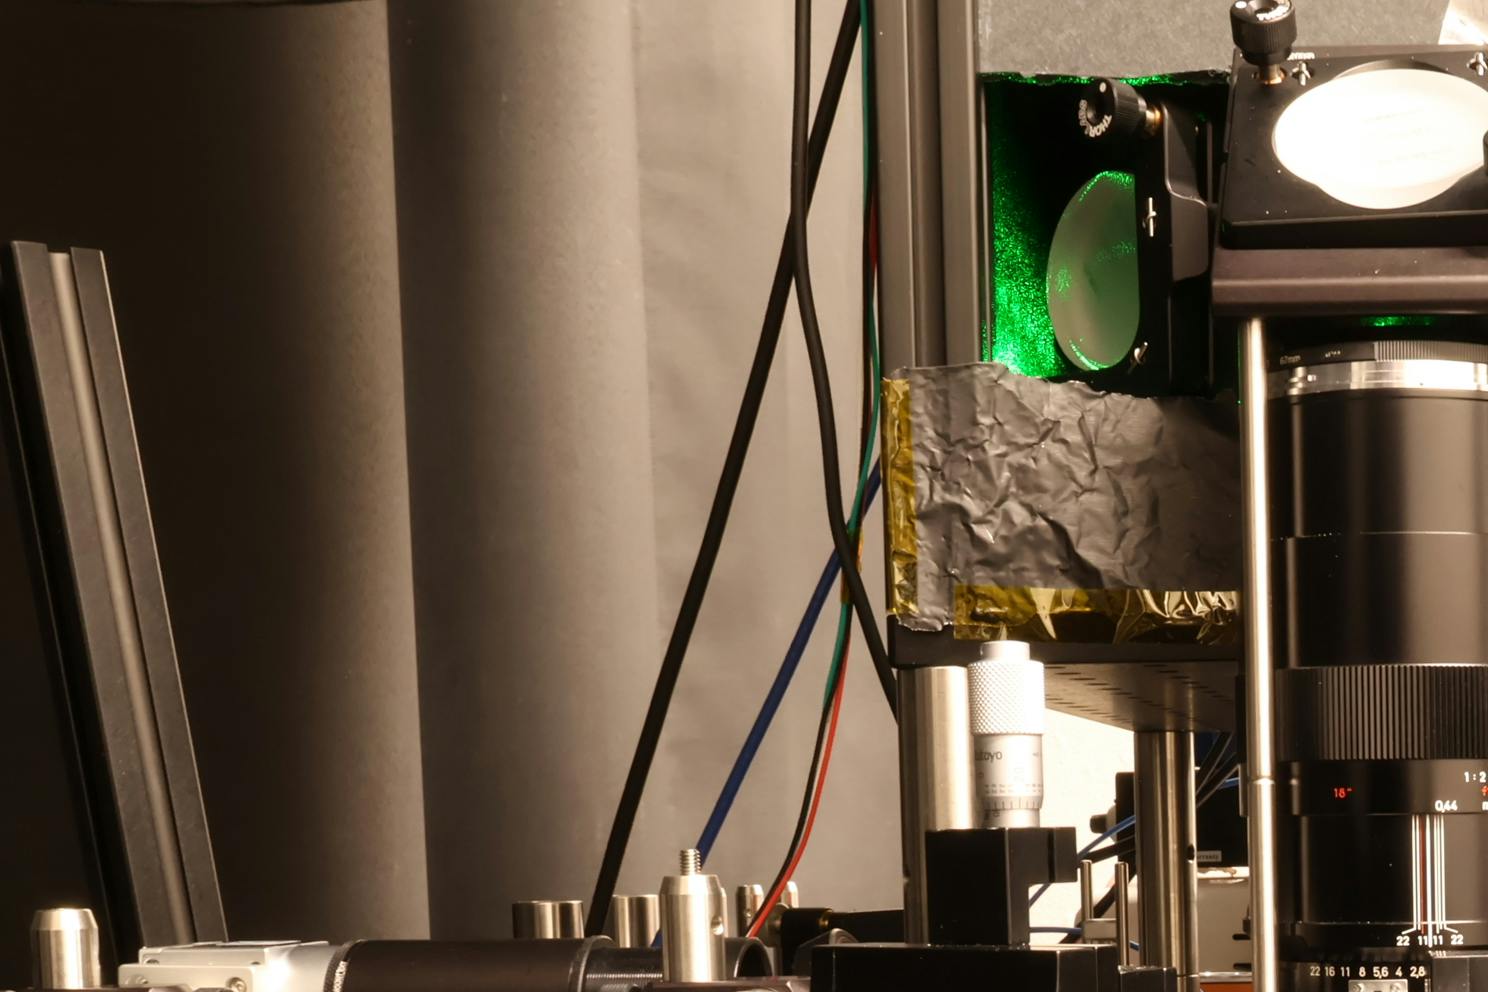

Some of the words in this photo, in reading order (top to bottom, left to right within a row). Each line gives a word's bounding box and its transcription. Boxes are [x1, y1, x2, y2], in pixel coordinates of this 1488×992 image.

[1396, 935, 1410, 946] 22
[1450, 933, 1464, 945] 22
[1309, 966, 1321, 977] 22
[1324, 966, 1336, 977] 16
[1340, 966, 1351, 977] 11
[1358, 966, 1366, 977] 8
[1372, 966, 1389, 979] 5,6
[1395, 966, 1403, 977] 4
[1409, 966, 1426, 979] 2,8
